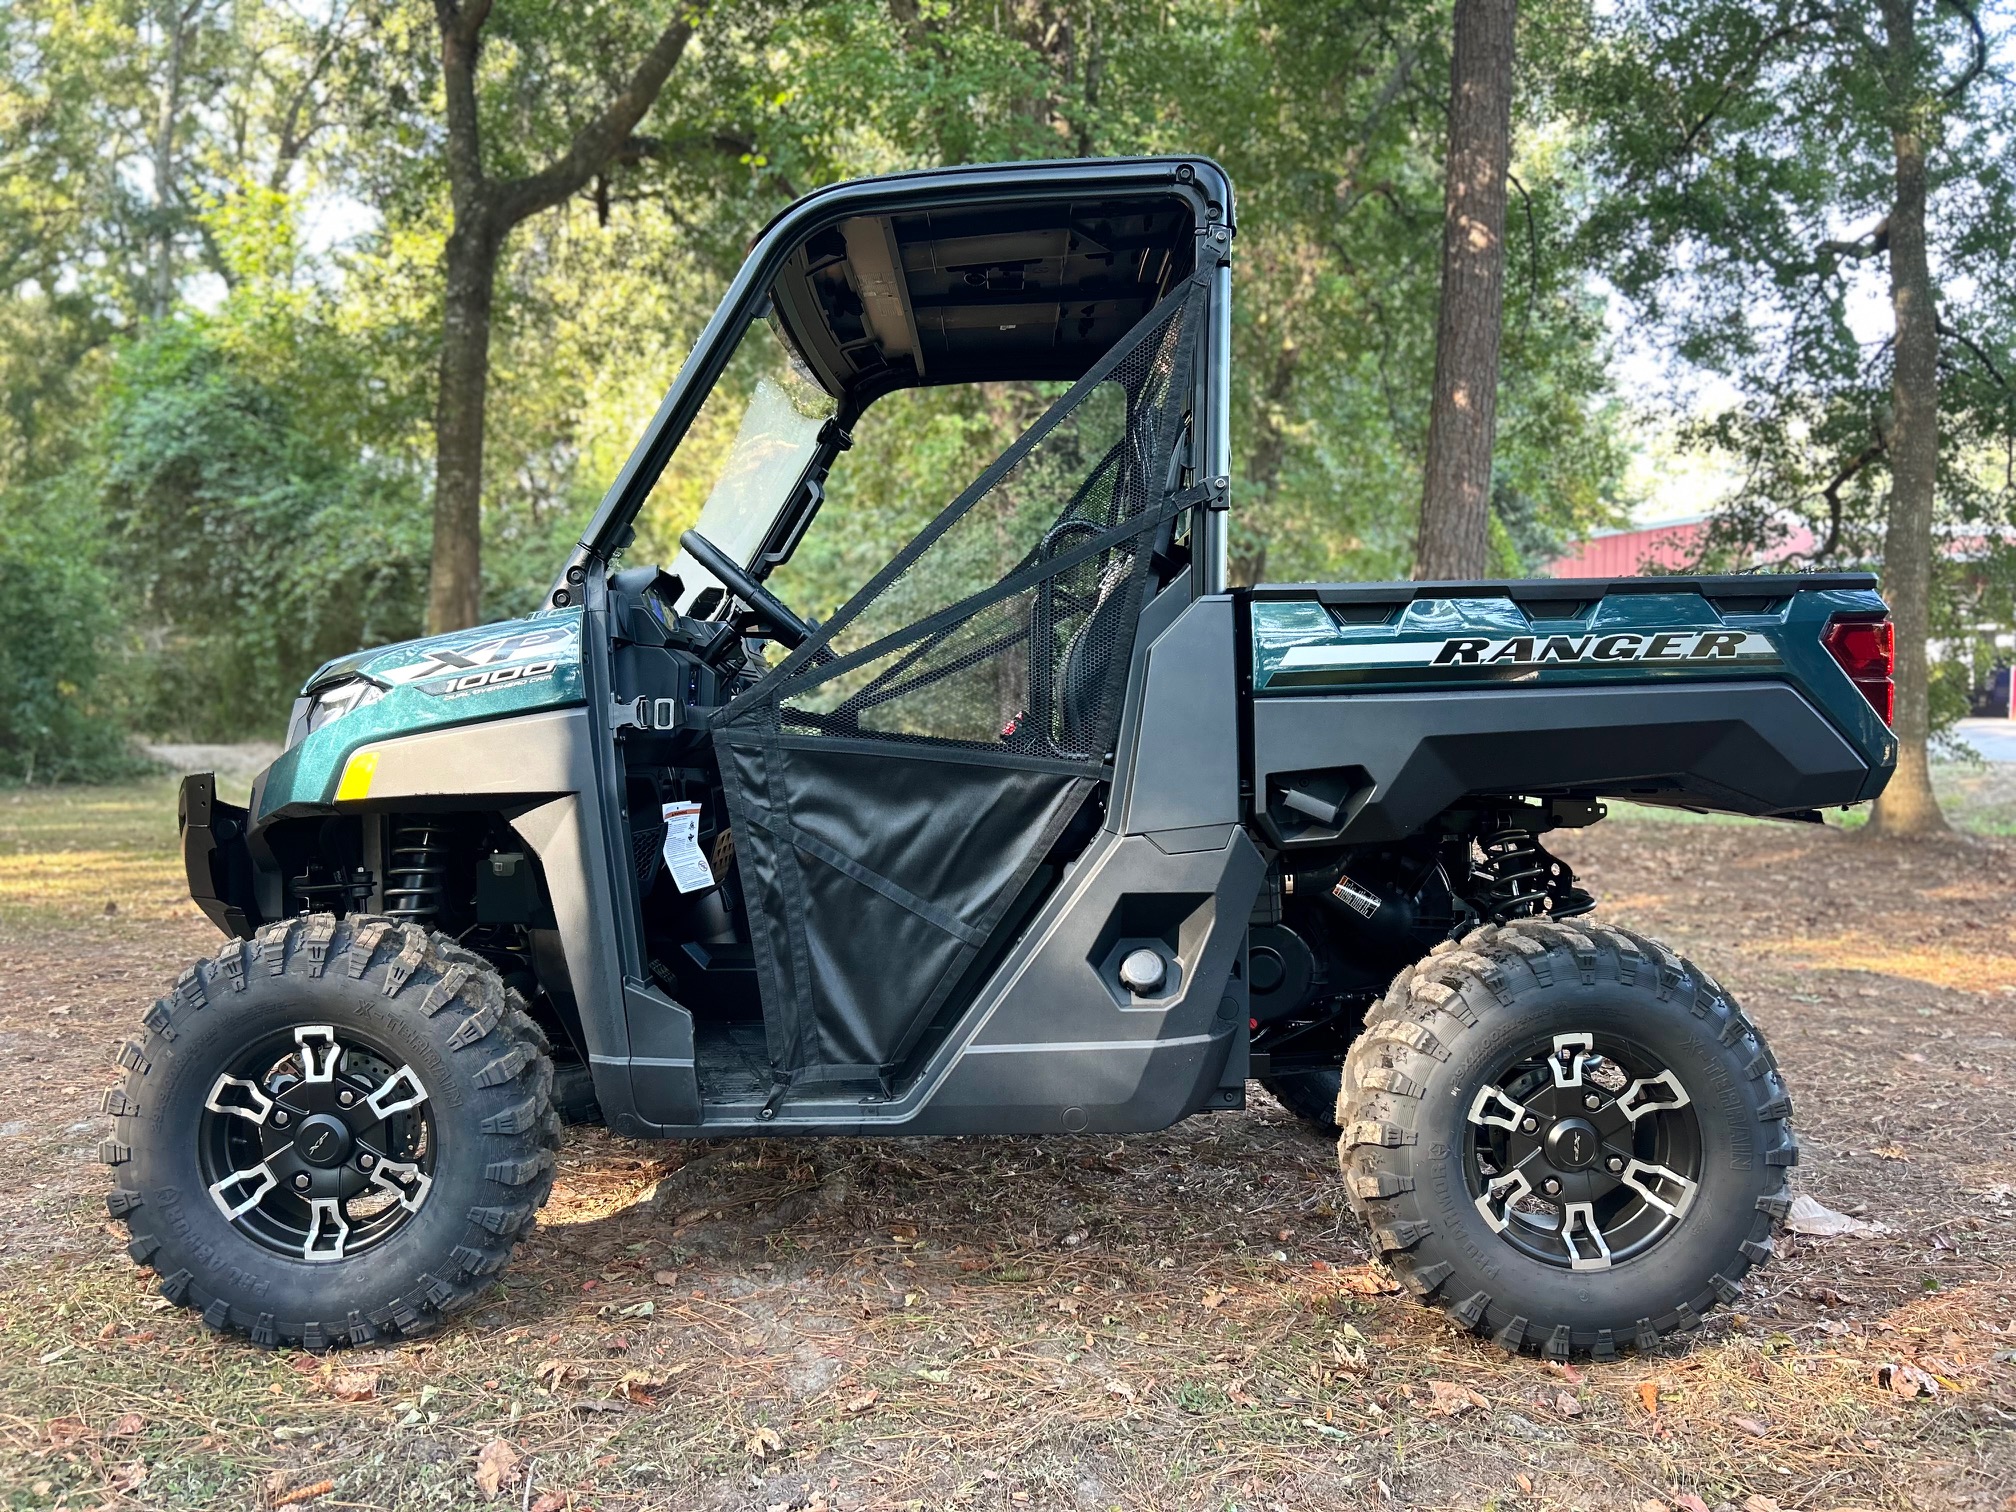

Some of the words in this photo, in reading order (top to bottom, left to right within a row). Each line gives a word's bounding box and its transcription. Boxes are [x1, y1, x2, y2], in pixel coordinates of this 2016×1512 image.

[409, 627, 571, 680] XP
[1430, 631, 1747, 666] RANGER
[445, 660, 557, 693] 1000
[473, 680, 527, 694] OVERHEAD
[529, 674, 553, 685] CAM
[352, 999, 465, 1109] X-TERRAIN
[1679, 1032, 1752, 1171] X-TERRAIN
